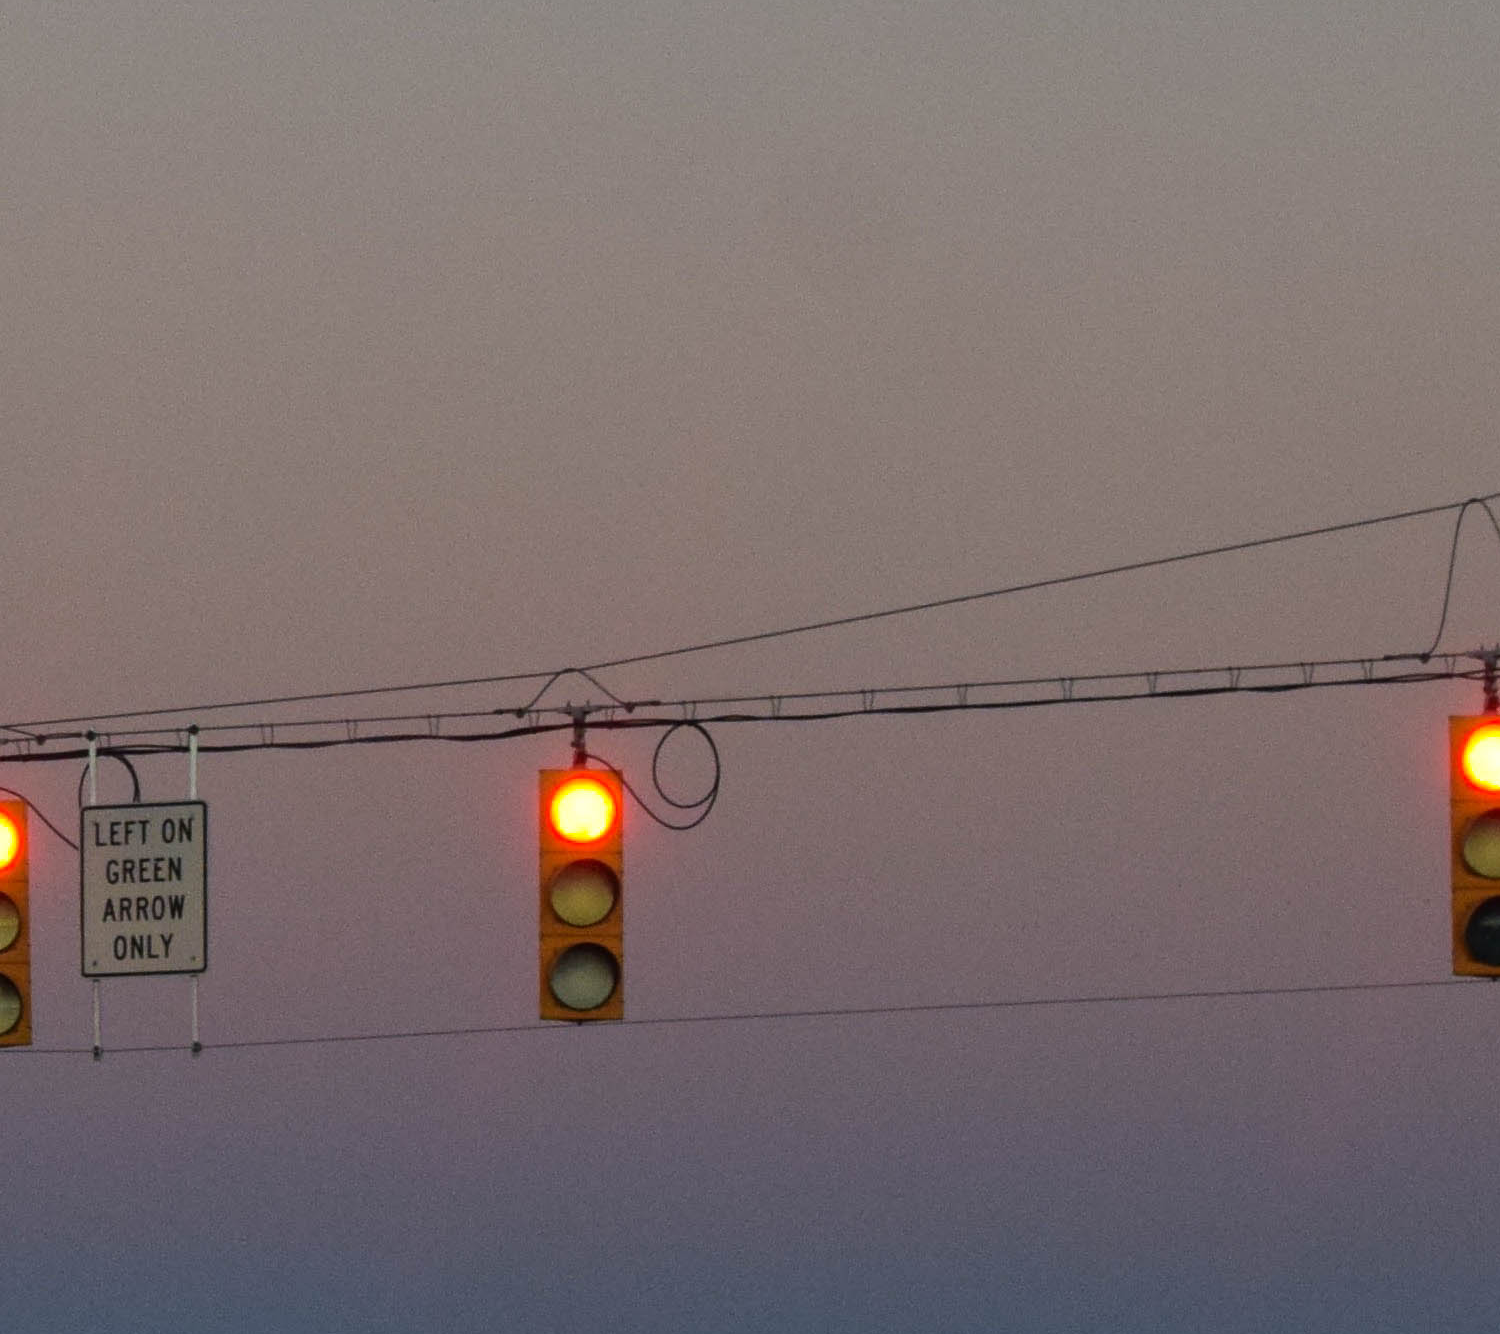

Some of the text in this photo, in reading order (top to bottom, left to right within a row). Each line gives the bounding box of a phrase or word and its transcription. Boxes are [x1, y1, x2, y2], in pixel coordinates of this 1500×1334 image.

[94, 818, 193, 847] LEFT ON
[106, 857, 182, 885] GREEN
[102, 895, 185, 923] ARROW
[113, 933, 173, 960] ONLY
